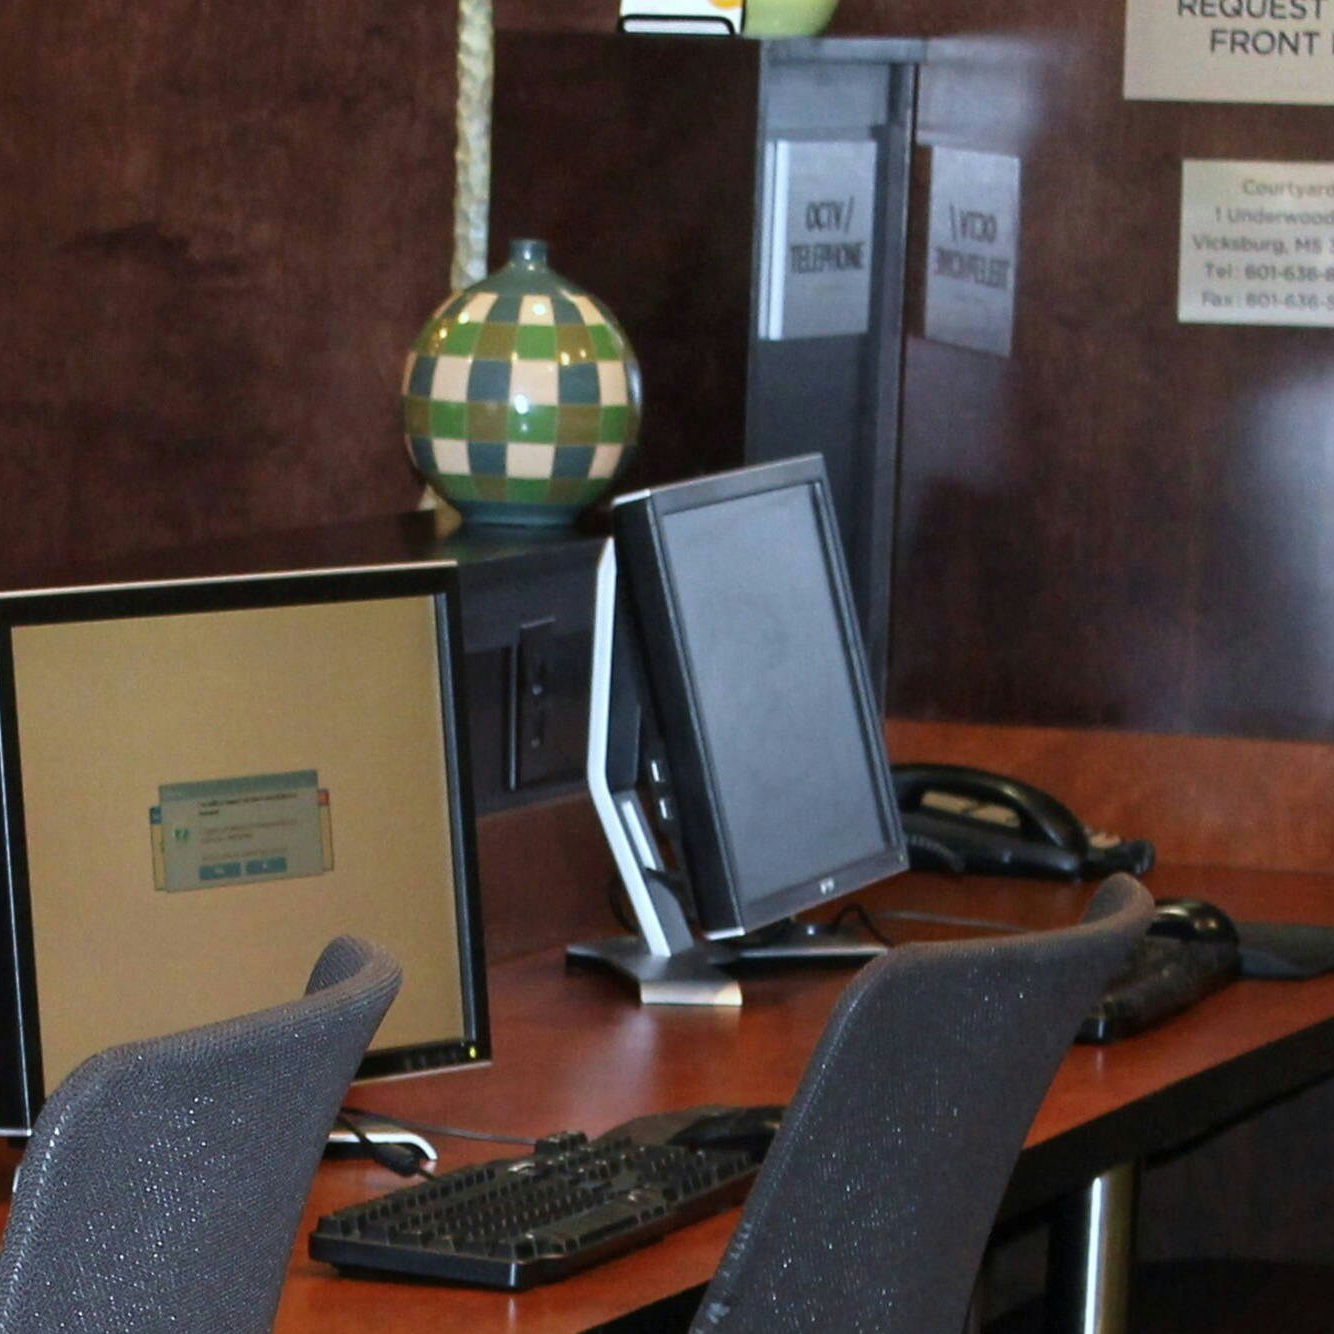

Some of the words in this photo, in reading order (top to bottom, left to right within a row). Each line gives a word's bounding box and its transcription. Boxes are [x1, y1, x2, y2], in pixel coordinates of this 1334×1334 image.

[1177, 0, 1327, 20] REQUEST
[1209, 28, 1320, 56] FRONT
[1295, 237, 1323, 253] MS
